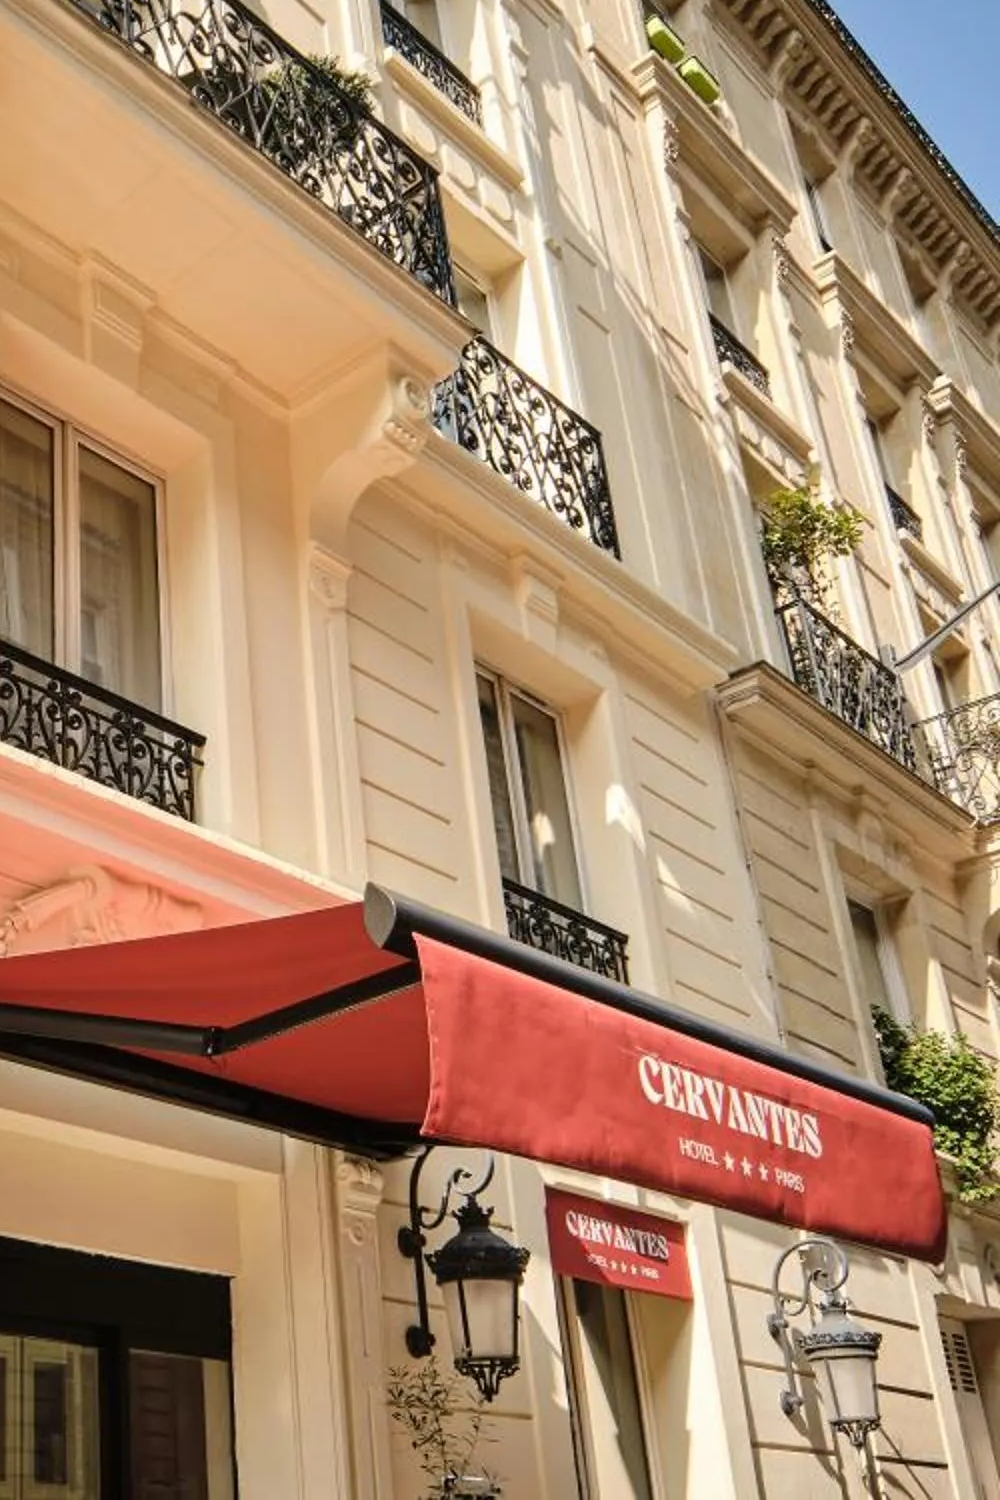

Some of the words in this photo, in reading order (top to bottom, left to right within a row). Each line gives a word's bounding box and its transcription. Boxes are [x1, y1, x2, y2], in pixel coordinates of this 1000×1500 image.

[638, 1055, 824, 1160] CERVANTES
[678, 1136, 719, 1168] HOTEL
[774, 1167, 805, 1194] PARIS
[565, 1209, 669, 1261] CERVANTES
